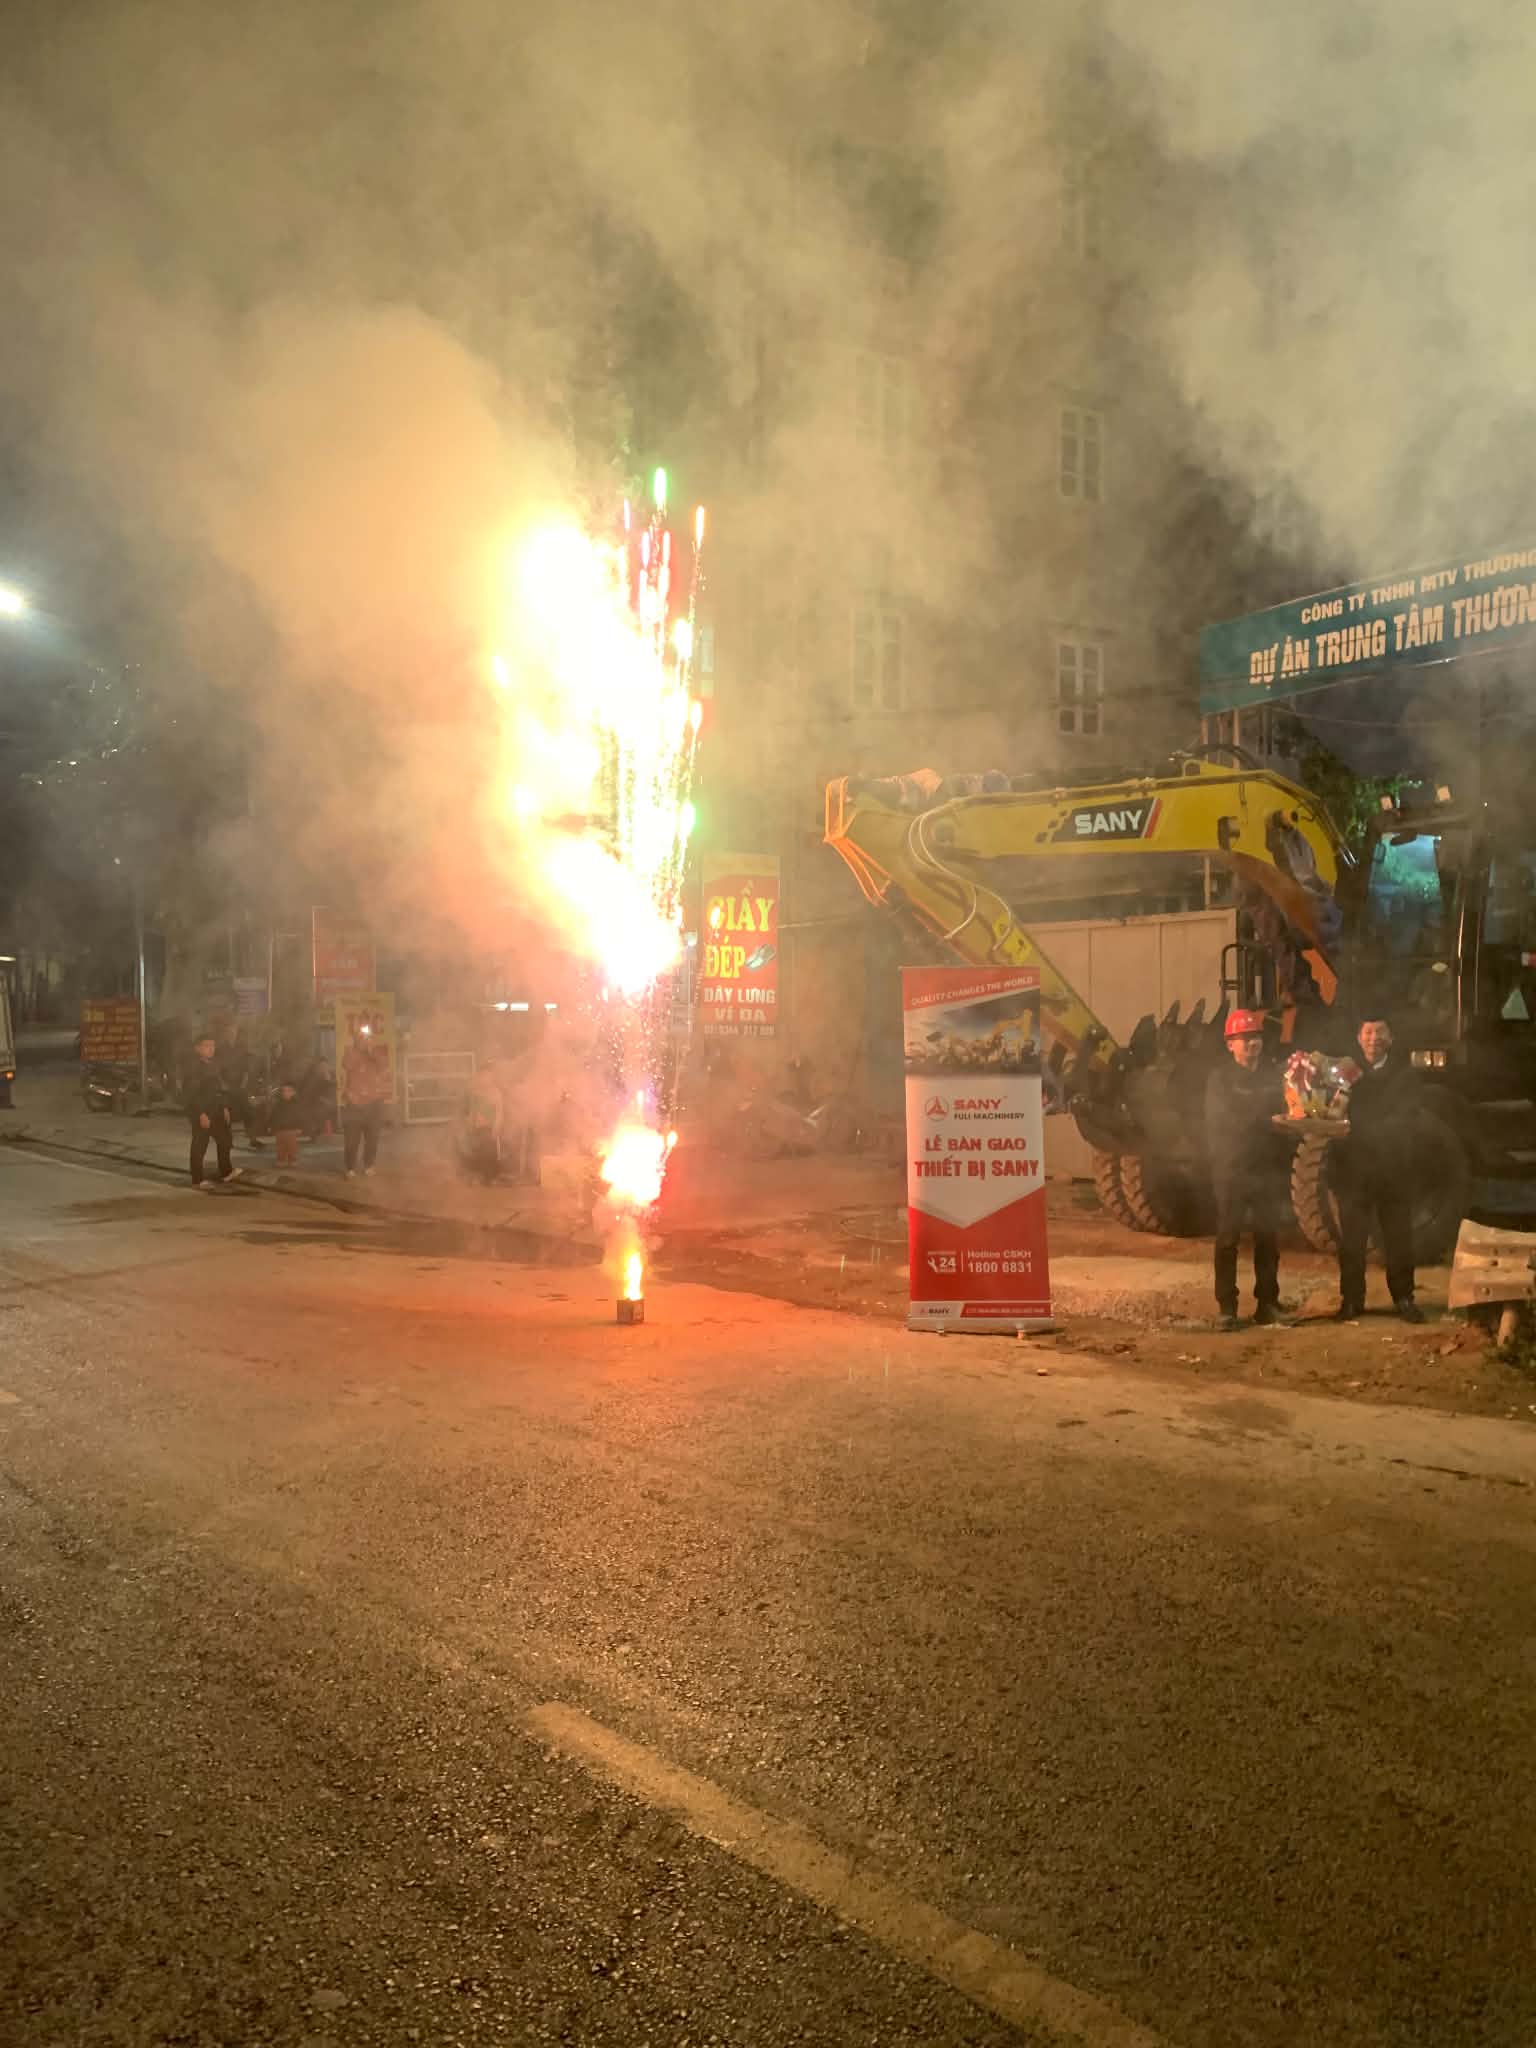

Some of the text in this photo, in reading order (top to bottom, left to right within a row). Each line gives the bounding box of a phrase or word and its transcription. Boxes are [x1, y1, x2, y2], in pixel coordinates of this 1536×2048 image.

[1302, 599, 1343, 624] CÔNG
[1348, 593, 1366, 612] TY
[1371, 580, 1415, 606] TNHH
[1421, 569, 1458, 594] MTV
[1249, 642, 1279, 691] DỰ
[1281, 635, 1310, 679] ÁN
[1316, 619, 1386, 667] TRUNG
[1394, 603, 1444, 652] TÂM
[1075, 810, 1142, 835] SANY
[704, 937, 746, 978] ĐÉP
[704, 986, 775, 1004] DÂY LƯNG
[911, 976, 1033, 1006] QUALITY CHANGES THE WORLD
[740, 1008, 766, 1022] DA
[954, 1099, 1002, 1111] SANY
[974, 1112, 1025, 1121] MACHINERY
[925, 1134, 1026, 1151] LỄ BÀN GIAO
[915, 1155, 1039, 1180] THIẾT BỊ SANY
[939, 1256, 956, 1267] 24
[967, 1250, 1001, 1259] Hotline
[968, 1261, 998, 1273] 1800
